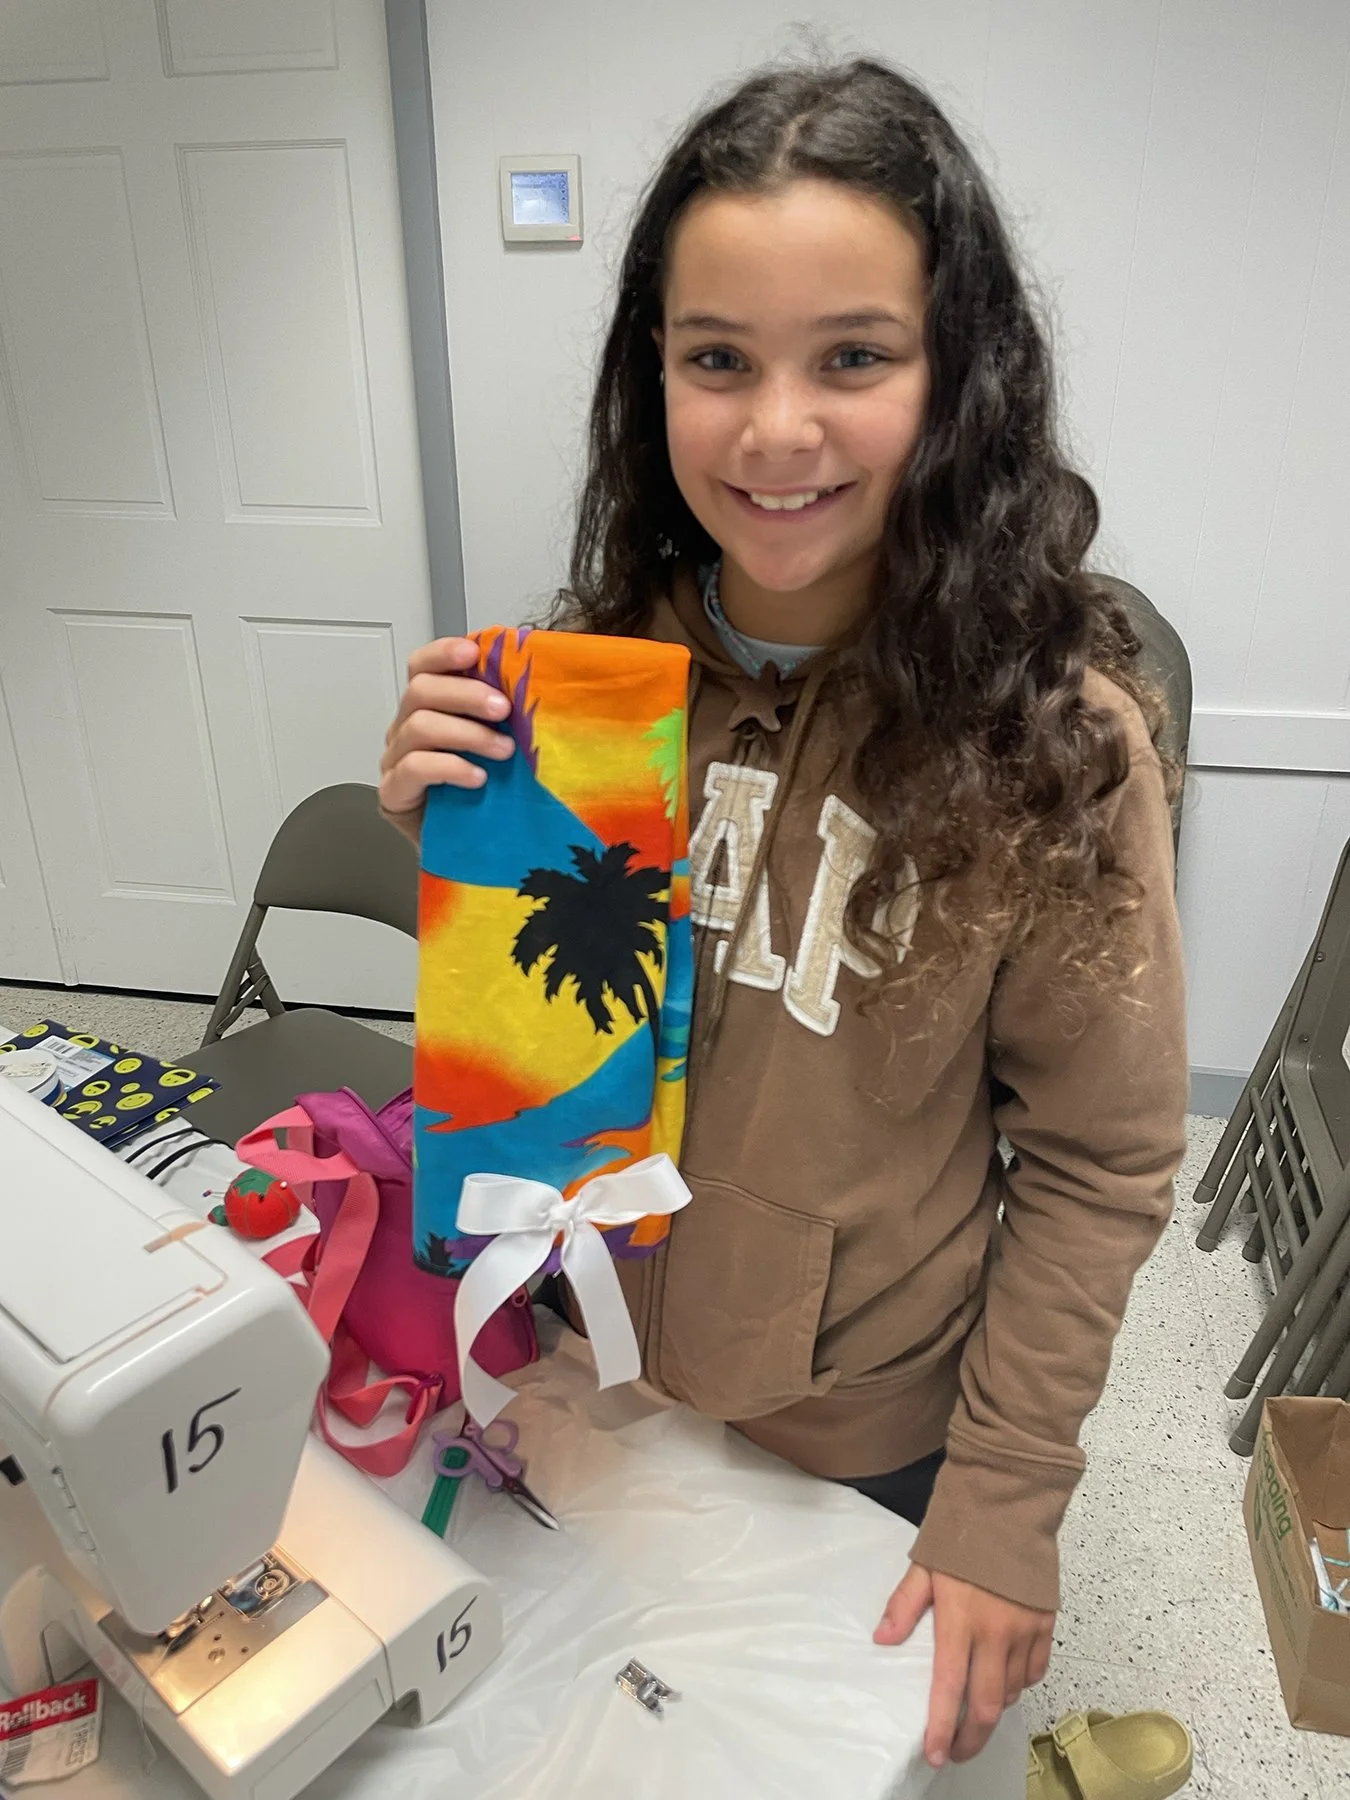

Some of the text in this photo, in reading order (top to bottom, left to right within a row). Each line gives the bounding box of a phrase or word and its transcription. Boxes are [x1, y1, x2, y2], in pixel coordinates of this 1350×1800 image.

[162, 1387, 242, 1493] 15
[436, 1594, 480, 1673] 15
[0, 1691, 88, 1733] Rollback
